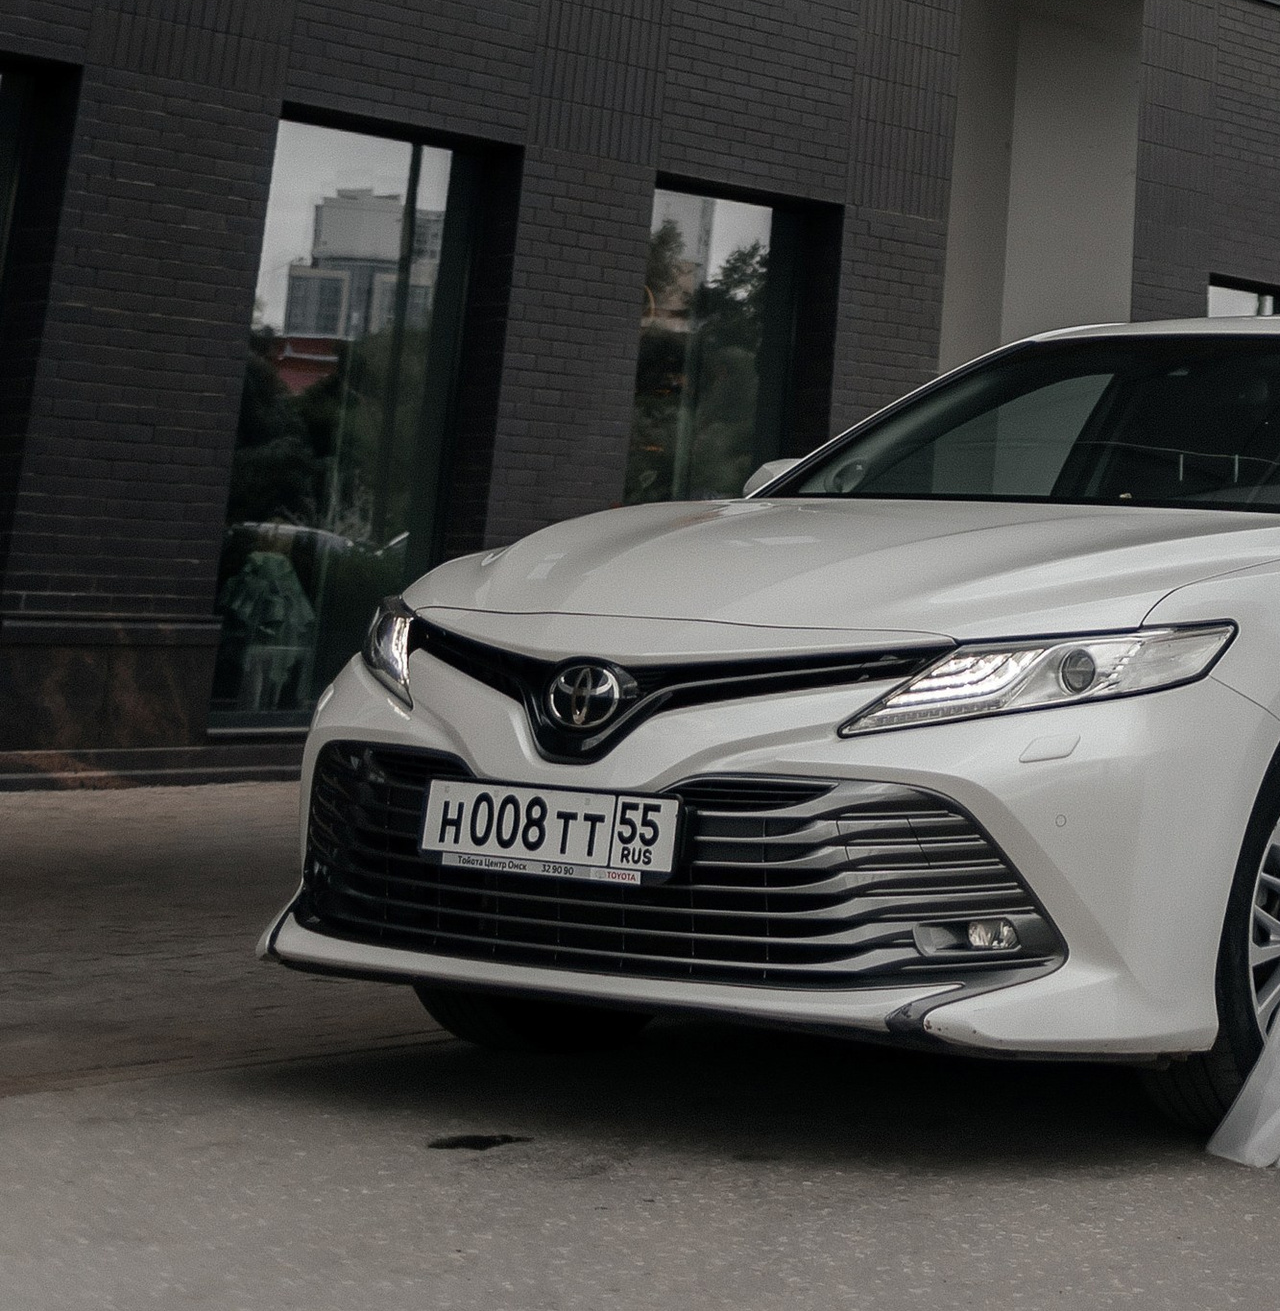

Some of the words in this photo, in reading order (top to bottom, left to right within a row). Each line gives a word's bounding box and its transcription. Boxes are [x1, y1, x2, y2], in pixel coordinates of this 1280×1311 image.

[617, 801, 662, 848] 55
[457, 855, 483, 867] Тойота
[484, 858, 507, 871] Центр
[620, 845, 653, 866] RUS
[606, 871, 636, 882] TOYOTA
